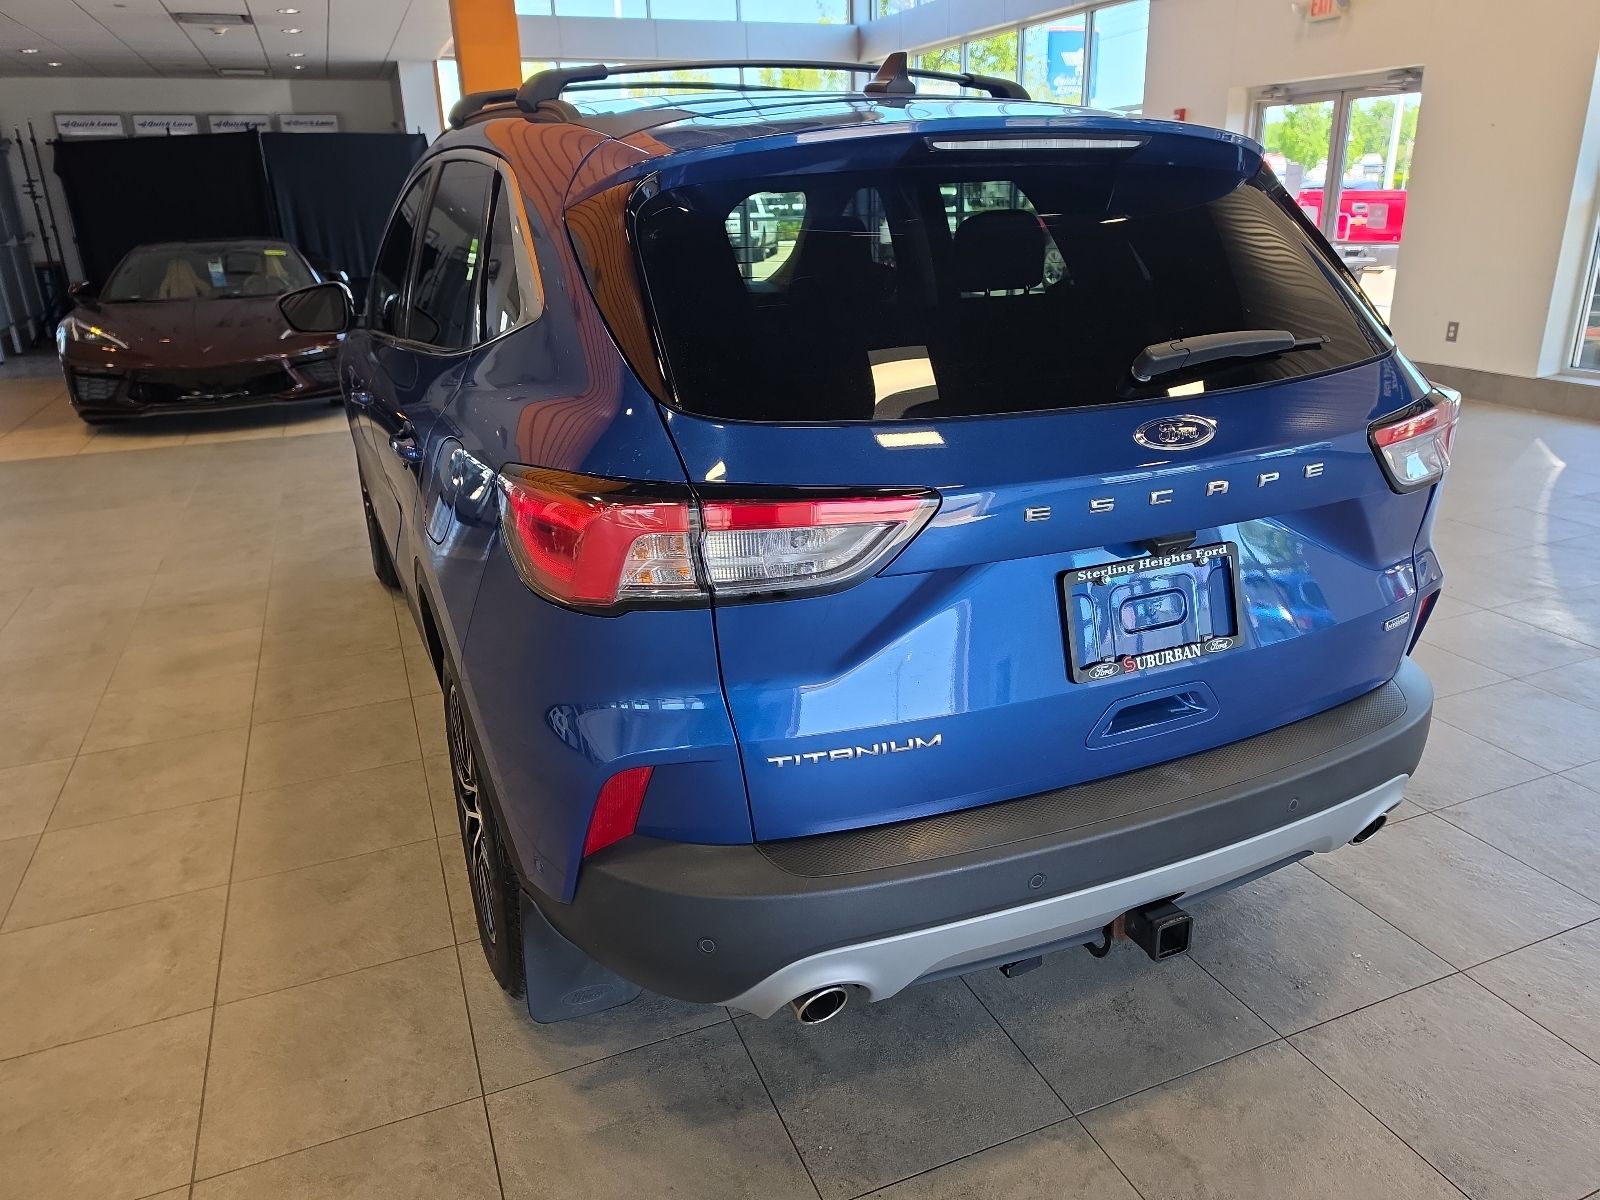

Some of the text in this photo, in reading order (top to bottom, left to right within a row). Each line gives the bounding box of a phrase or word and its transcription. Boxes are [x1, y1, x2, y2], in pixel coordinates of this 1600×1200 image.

[70, 120, 118, 128] Quick Lane
[146, 120, 194, 128] Quick Lane
[1158, 420, 1201, 443] Ford
[1023, 461, 1325, 523] ESCAPE
[1077, 544, 1228, 582] Sterling Heights Ford
[1208, 638, 1230, 651] Ford
[1122, 643, 1202, 674] SUBURBAN
[1093, 664, 1115, 677] Ford
[766, 733, 943, 768] TITANIUM
